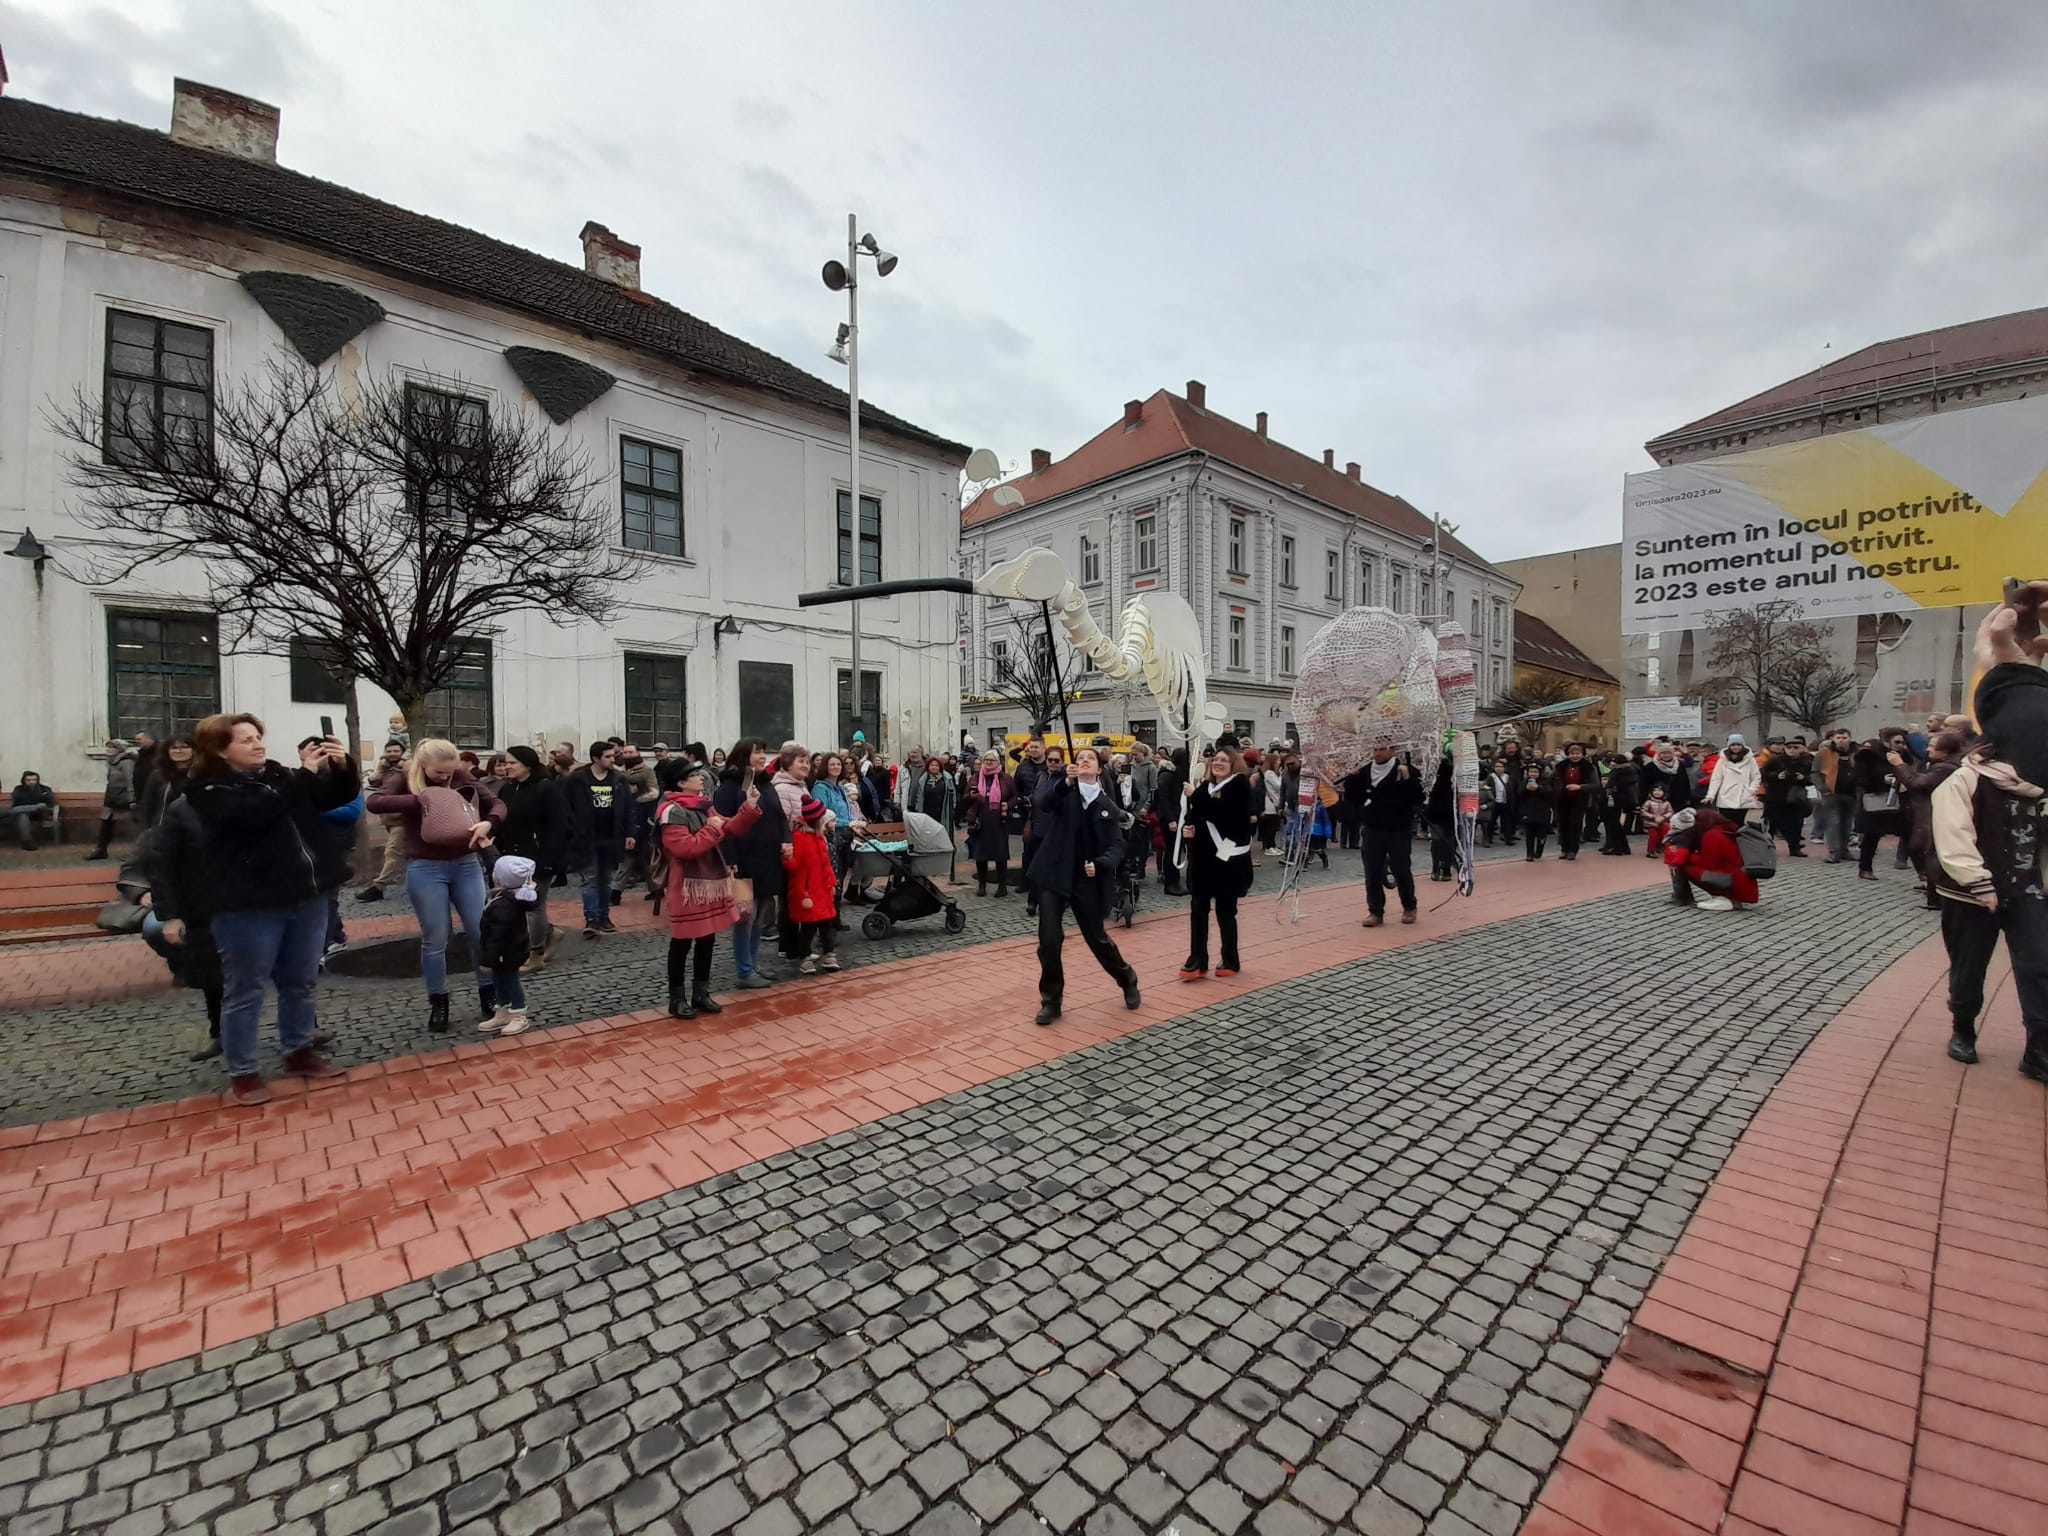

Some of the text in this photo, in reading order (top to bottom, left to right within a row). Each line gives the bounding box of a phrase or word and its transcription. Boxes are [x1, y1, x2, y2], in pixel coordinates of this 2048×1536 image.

[1634, 491, 1983, 557] Suntem în locul potrivit,
[1634, 555, 1960, 605] 2023 este anul nostru.
[1635, 527, 1934, 581] la momentul potrivit.
